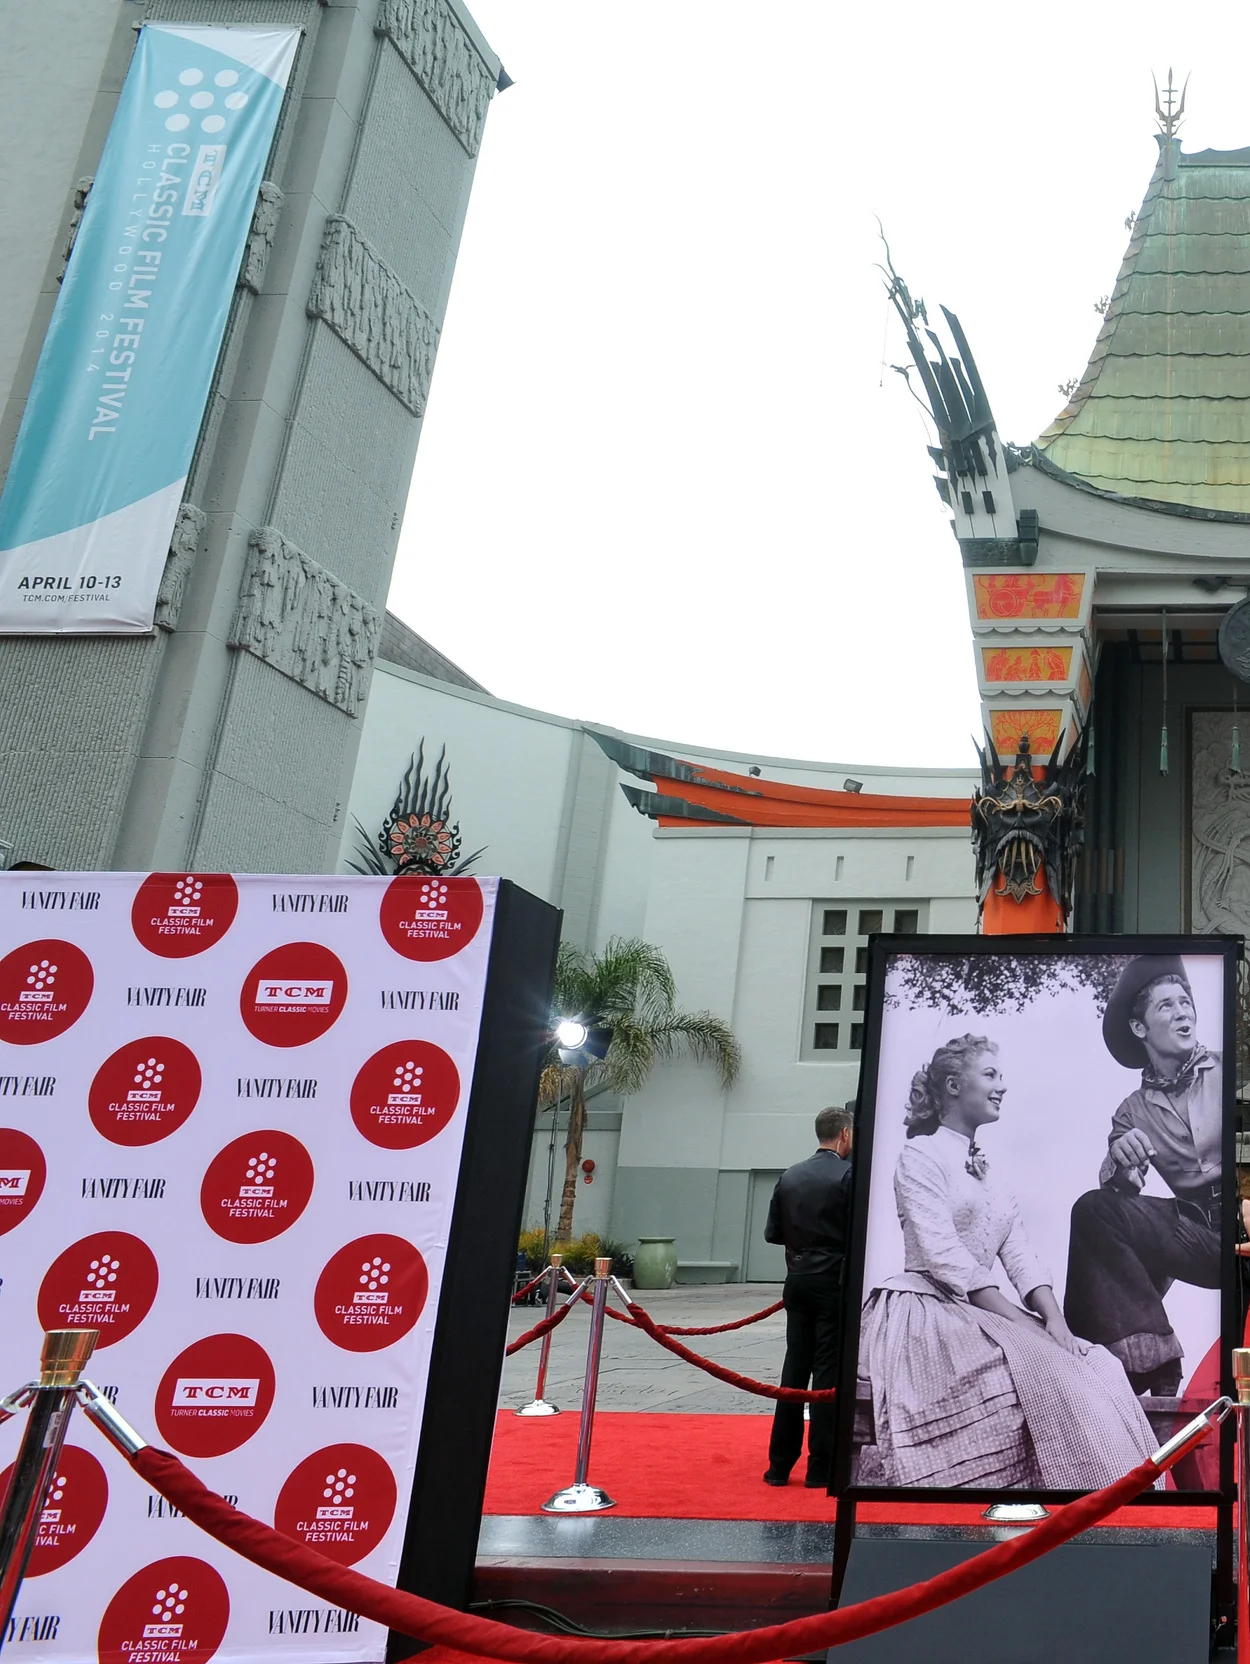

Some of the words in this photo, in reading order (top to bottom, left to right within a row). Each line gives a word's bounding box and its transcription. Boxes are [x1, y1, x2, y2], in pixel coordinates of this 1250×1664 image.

[191, 149, 217, 211] TCM
[142, 143, 191, 242] CLASSIC
[109, 144, 161, 291] HOLLYWOOD
[124, 250, 162, 308] FILM
[86, 314, 114, 372] 2014
[88, 318, 144, 441] FESTIVAL
[17, 576, 72, 590] APRIL
[79, 575, 122, 589] 10-13
[22, 594, 110, 603] TCM.COM/FESTIVAL
[21, 892, 66, 909] VANITY
[70, 892, 101, 909] FAIR
[272, 894, 315, 912] VANITY
[319, 895, 349, 912] FAIR
[440, 922, 461, 930] FILM
[408, 930, 449, 938] FESTIVAL
[265, 987, 325, 997] TCM
[127, 988, 171, 1006] VANITY
[175, 988, 207, 1006] FAIR
[381, 991, 425, 1009] VANITY
[430, 992, 460, 1010] FAIR
[255, 1005, 278, 1013] TURNER
[279, 1005, 306, 1013] CLASSIC
[9, 1012, 52, 1020] FESTIVAL
[237, 1079, 283, 1097] VANITY
[286, 1080, 318, 1098] FAIR
[390, 1095, 420, 1103] TCM
[109, 1103, 149, 1111] CLASSIC
[370, 1106, 410, 1114] CLASSIC
[117, 1112, 161, 1120] FESTIVAL
[379, 1116, 422, 1124] FESTIVAL
[81, 1179, 129, 1198] VANITY
[132, 1179, 166, 1198] FAIR
[349, 1181, 395, 1201] VANITY
[399, 1182, 431, 1202] FAIR
[222, 1199, 262, 1207] CLASSIC
[230, 1209, 274, 1217] FESTIVAL
[196, 1278, 243, 1298] VANITY
[247, 1278, 281, 1298] FAIR
[60, 1304, 102, 1312] CLASSIC
[105, 1304, 129, 1312] FILM
[336, 1306, 376, 1314] CLASSIC
[379, 1306, 402, 1314] FILM
[68, 1314, 114, 1322] FESTIVAL
[344, 1316, 389, 1324] FESTIVAL
[183, 1386, 251, 1398] TCM
[313, 1387, 361, 1408] VANITY
[365, 1387, 399, 1408] FAIR
[172, 1409, 197, 1417] TURNER
[198, 1408, 229, 1417] CLASSIC
[231, 1409, 253, 1417] MOVIES
[319, 1509, 352, 1517] TCM
[297, 1522, 341, 1530] CLASSIC
[344, 1522, 368, 1530] FILM
[306, 1532, 354, 1541] FESTIVAL
[268, 1610, 320, 1633] VANITY
[324, 1610, 361, 1633] FAIR
[146, 1627, 181, 1635] TCM
[122, 1640, 168, 1650] CLASSIC
[172, 1640, 198, 1649] FILM
[129, 1652, 180, 1662] FESTIVAL
